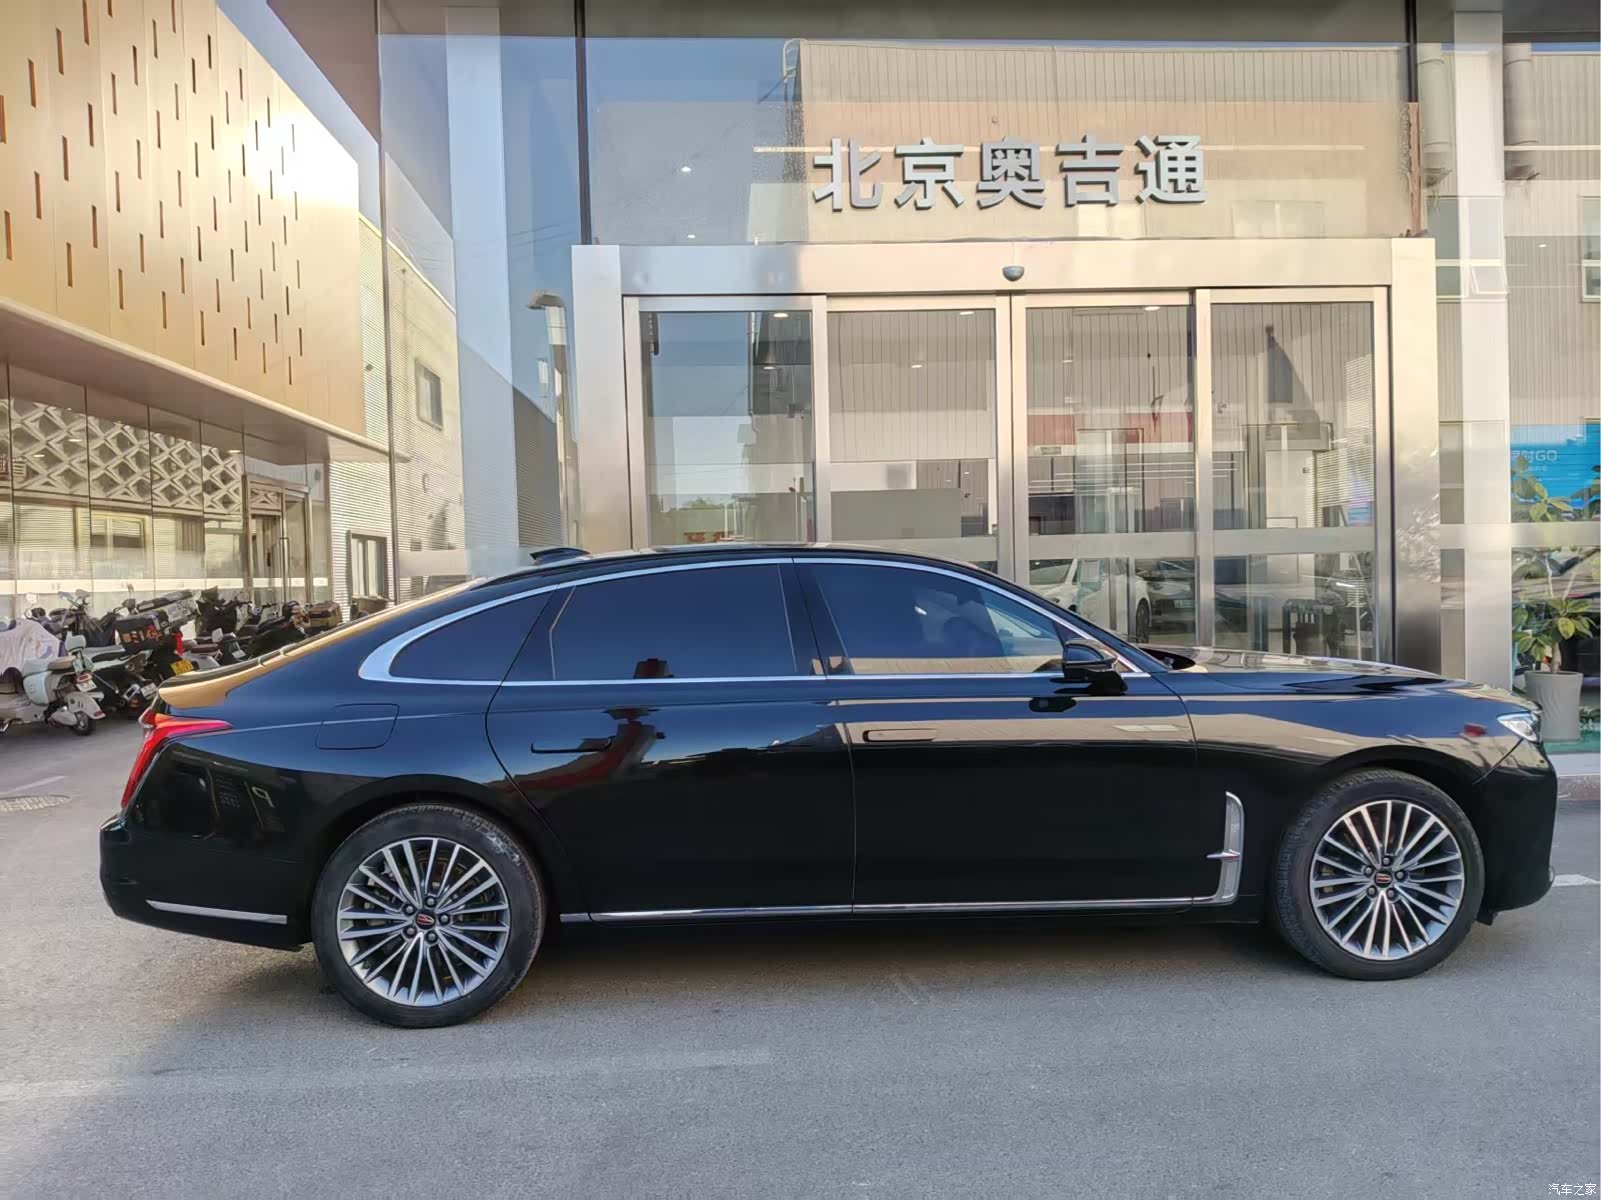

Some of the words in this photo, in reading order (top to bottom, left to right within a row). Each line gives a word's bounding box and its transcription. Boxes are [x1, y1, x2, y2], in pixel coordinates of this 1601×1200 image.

[813, 134, 1209, 212] 北京奥吉通
